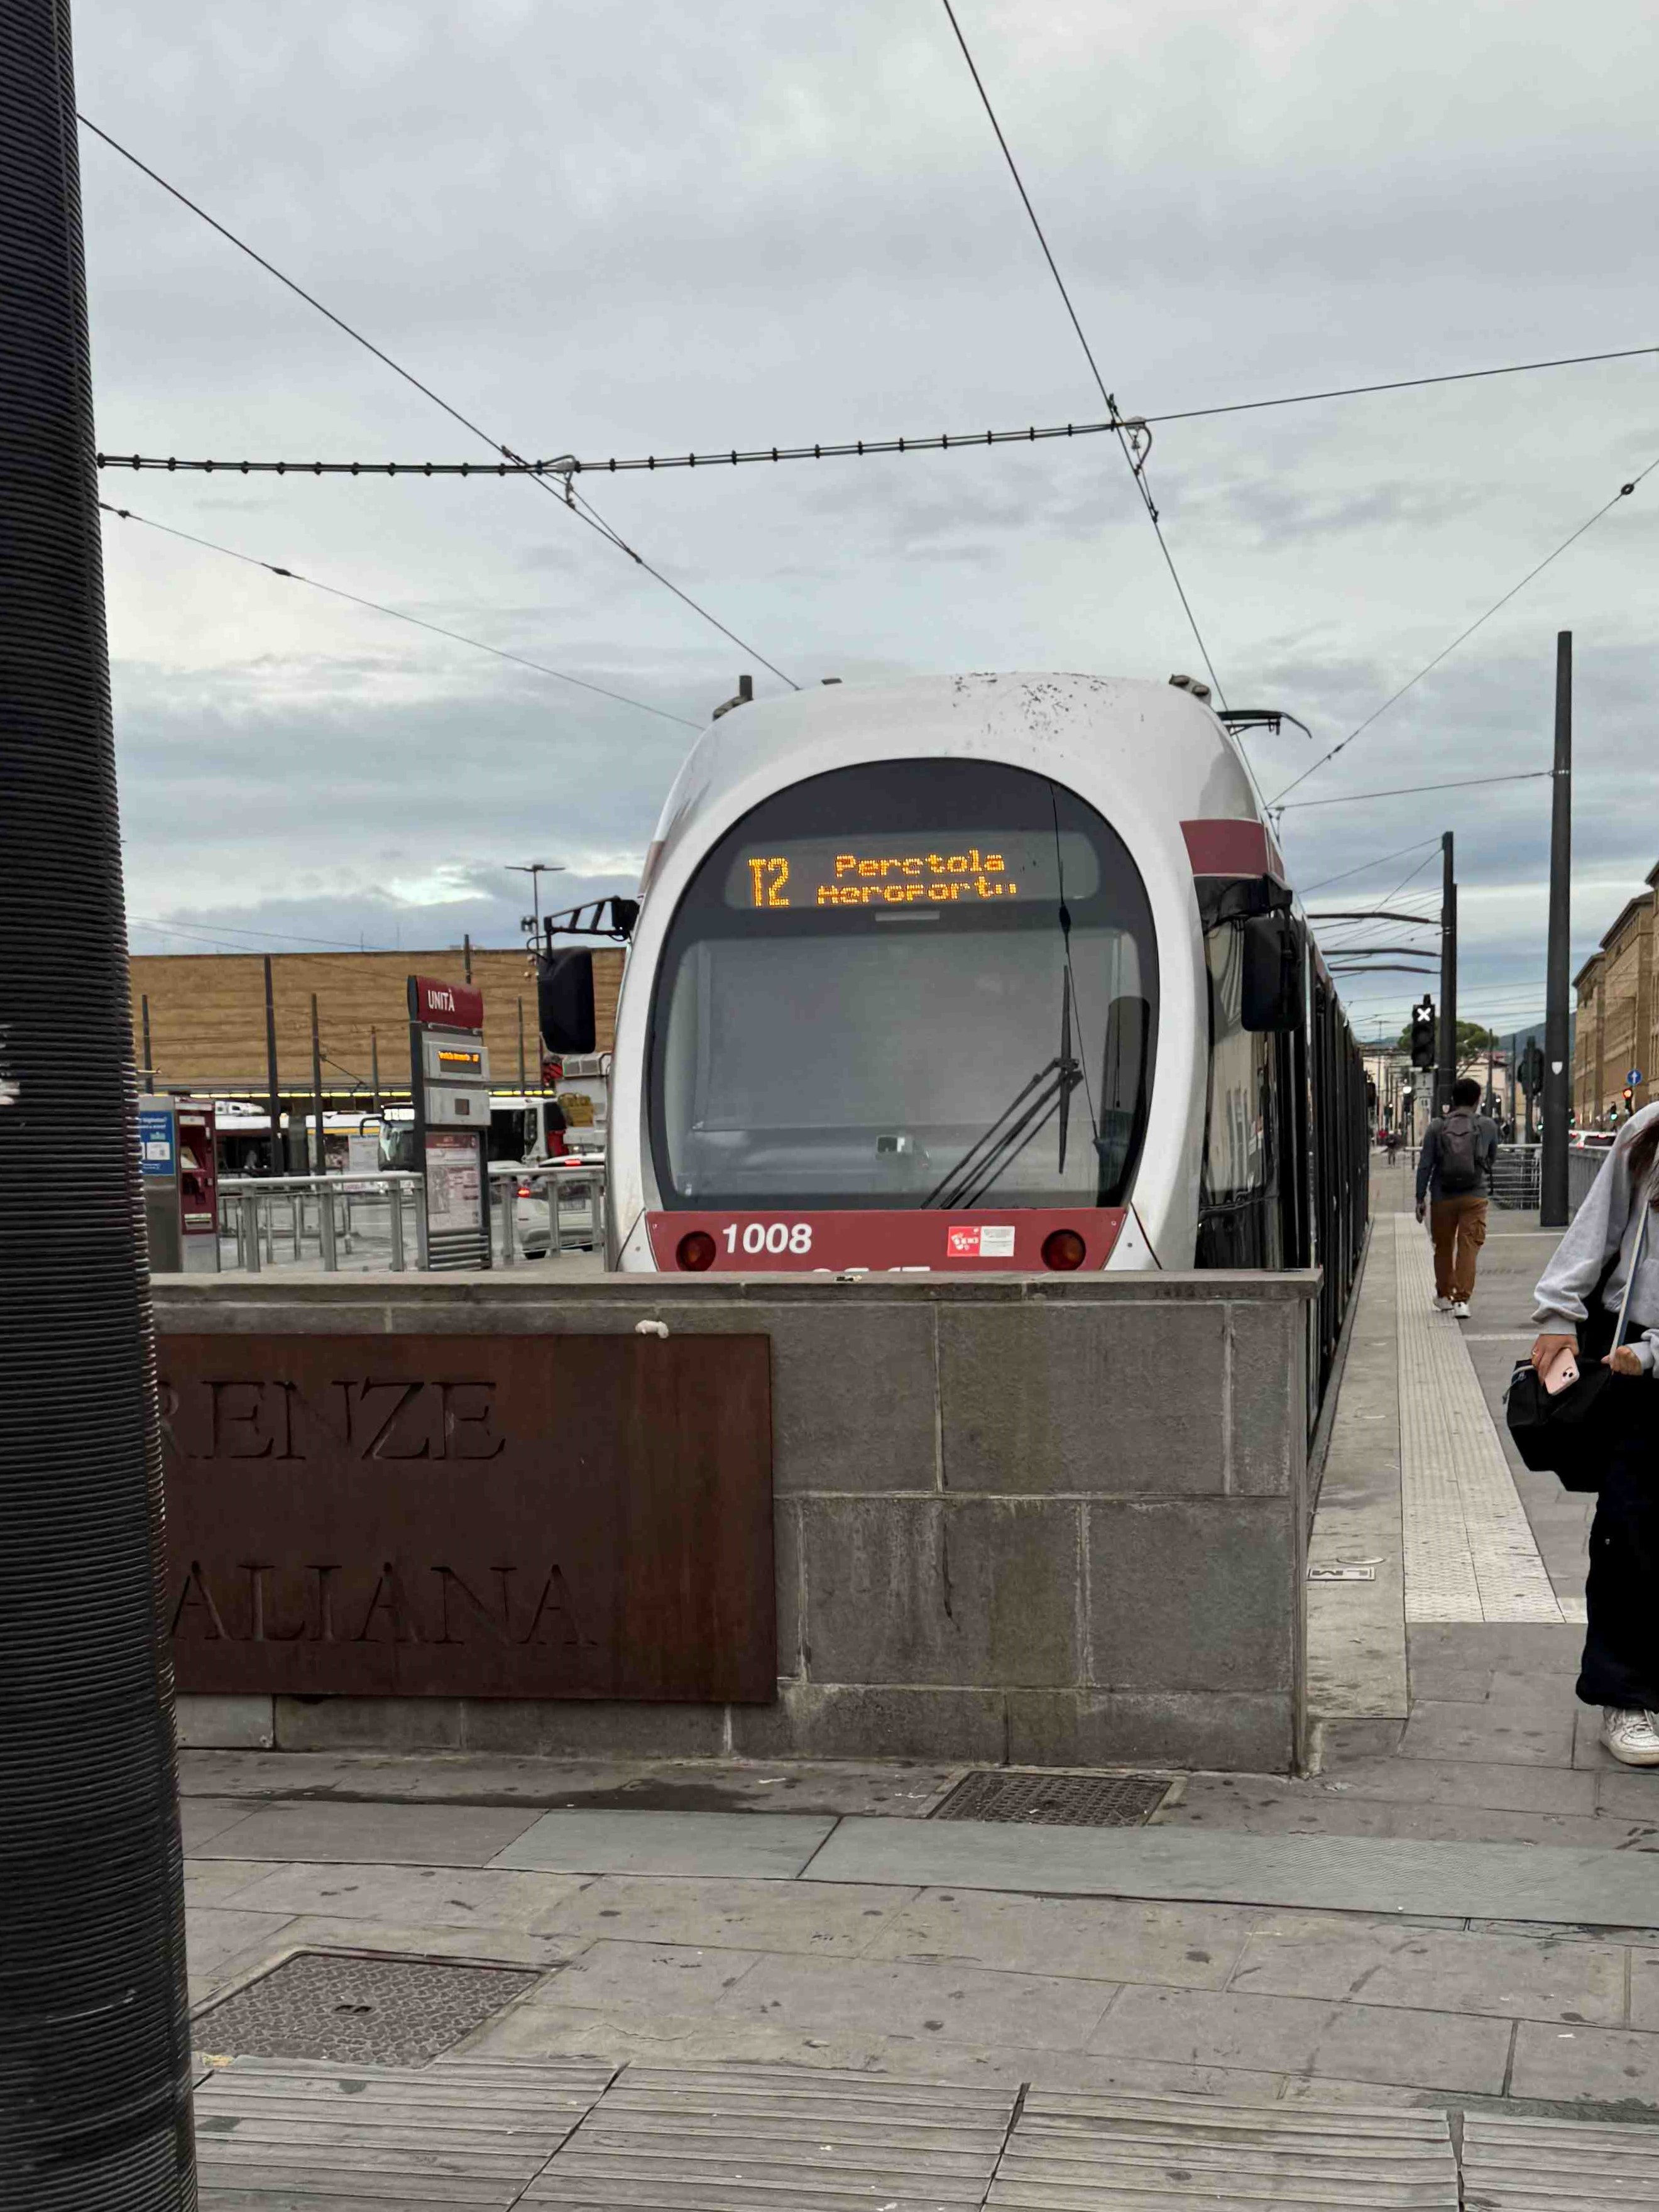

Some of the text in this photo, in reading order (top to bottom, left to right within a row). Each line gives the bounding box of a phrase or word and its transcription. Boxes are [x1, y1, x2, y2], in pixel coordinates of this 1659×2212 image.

[749, 857, 789, 906] T2
[428, 988, 455, 1012] UNITÀ
[723, 1223, 812, 1254] 1008
[157, 1377, 506, 1461] RENZE
[170, 1562, 598, 1645] ALIANA
